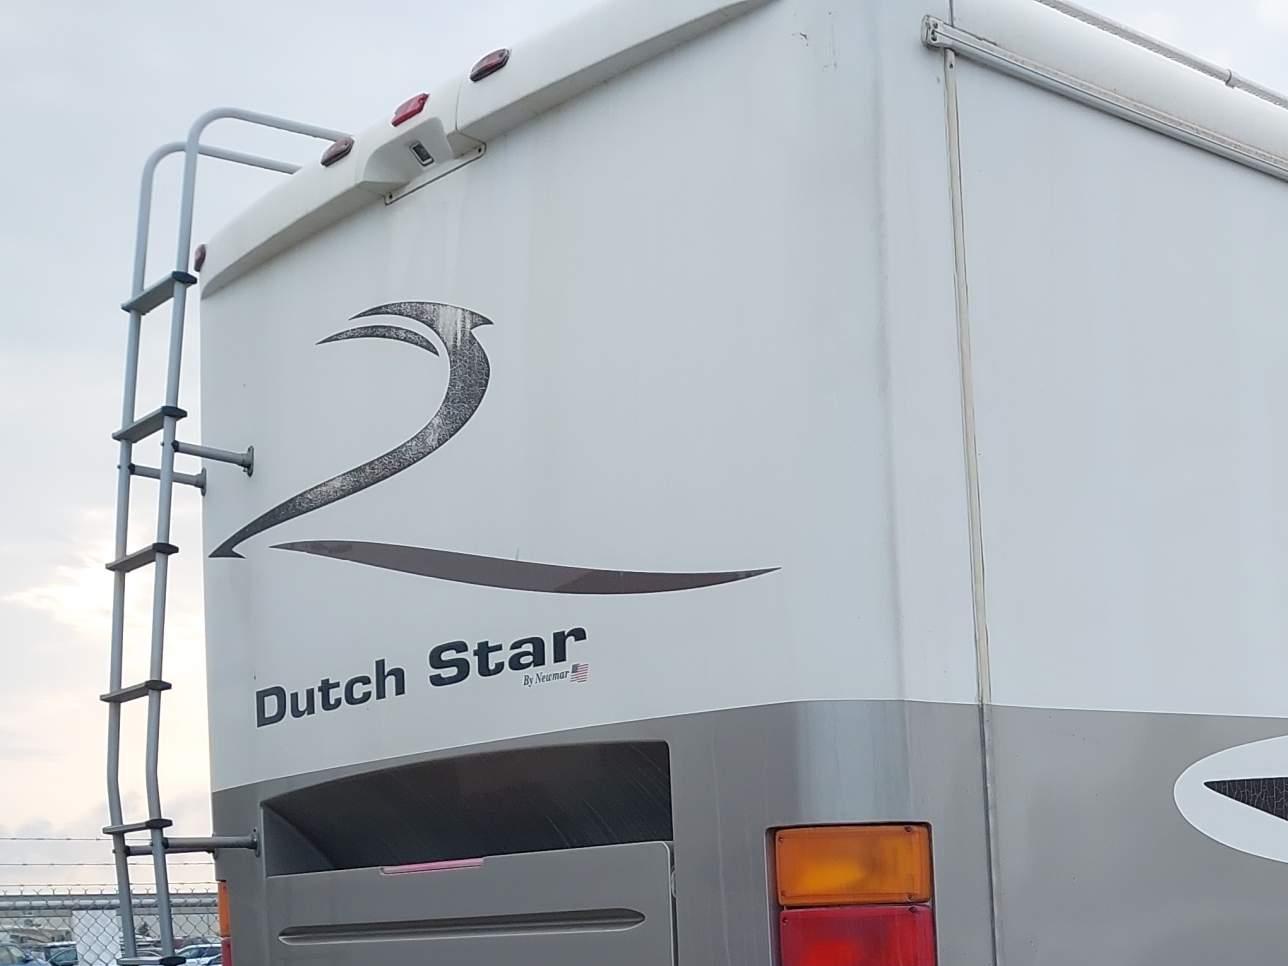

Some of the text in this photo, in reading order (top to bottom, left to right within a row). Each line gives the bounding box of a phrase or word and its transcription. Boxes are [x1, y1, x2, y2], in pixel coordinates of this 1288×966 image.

[256, 626, 588, 728] Dutch Star
[523, 674, 534, 688] By
